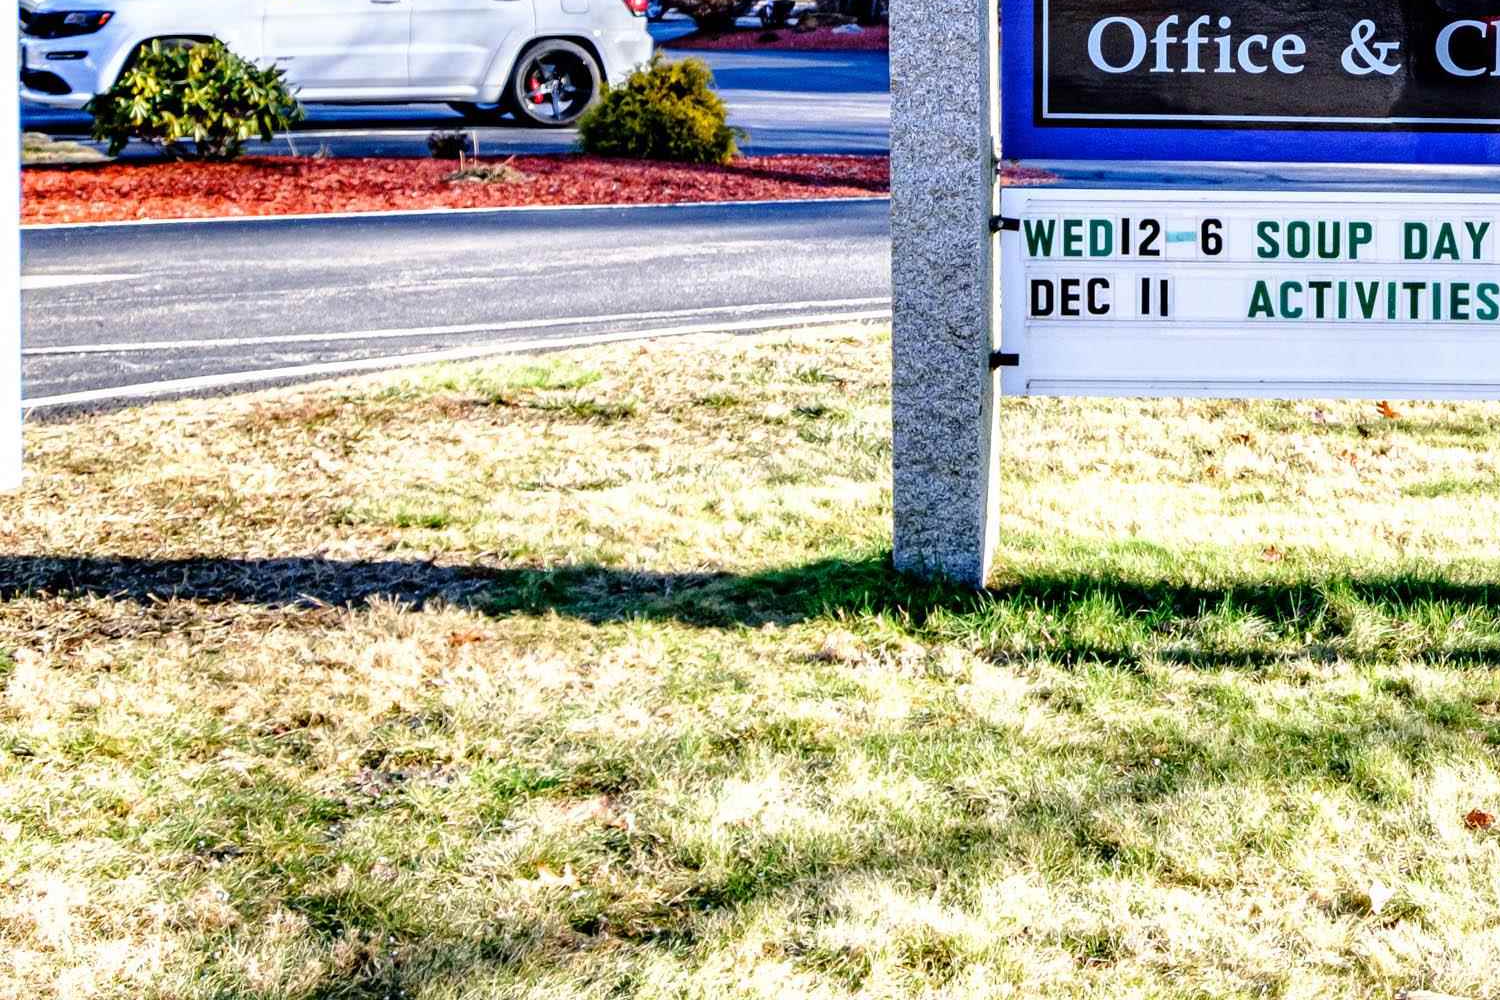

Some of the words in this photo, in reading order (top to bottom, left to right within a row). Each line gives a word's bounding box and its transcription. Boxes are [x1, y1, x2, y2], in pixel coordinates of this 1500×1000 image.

[1088, 14, 1306, 74] Office
[1340, 19, 1401, 75] &
[1257, 220, 1373, 260] SOUP
[1404, 221, 1490, 260] DAY
[1030, 277, 1110, 317] DEC
[1141, 278, 1168, 317] 11
[1247, 280, 1500, 321] ACTIVITIES
